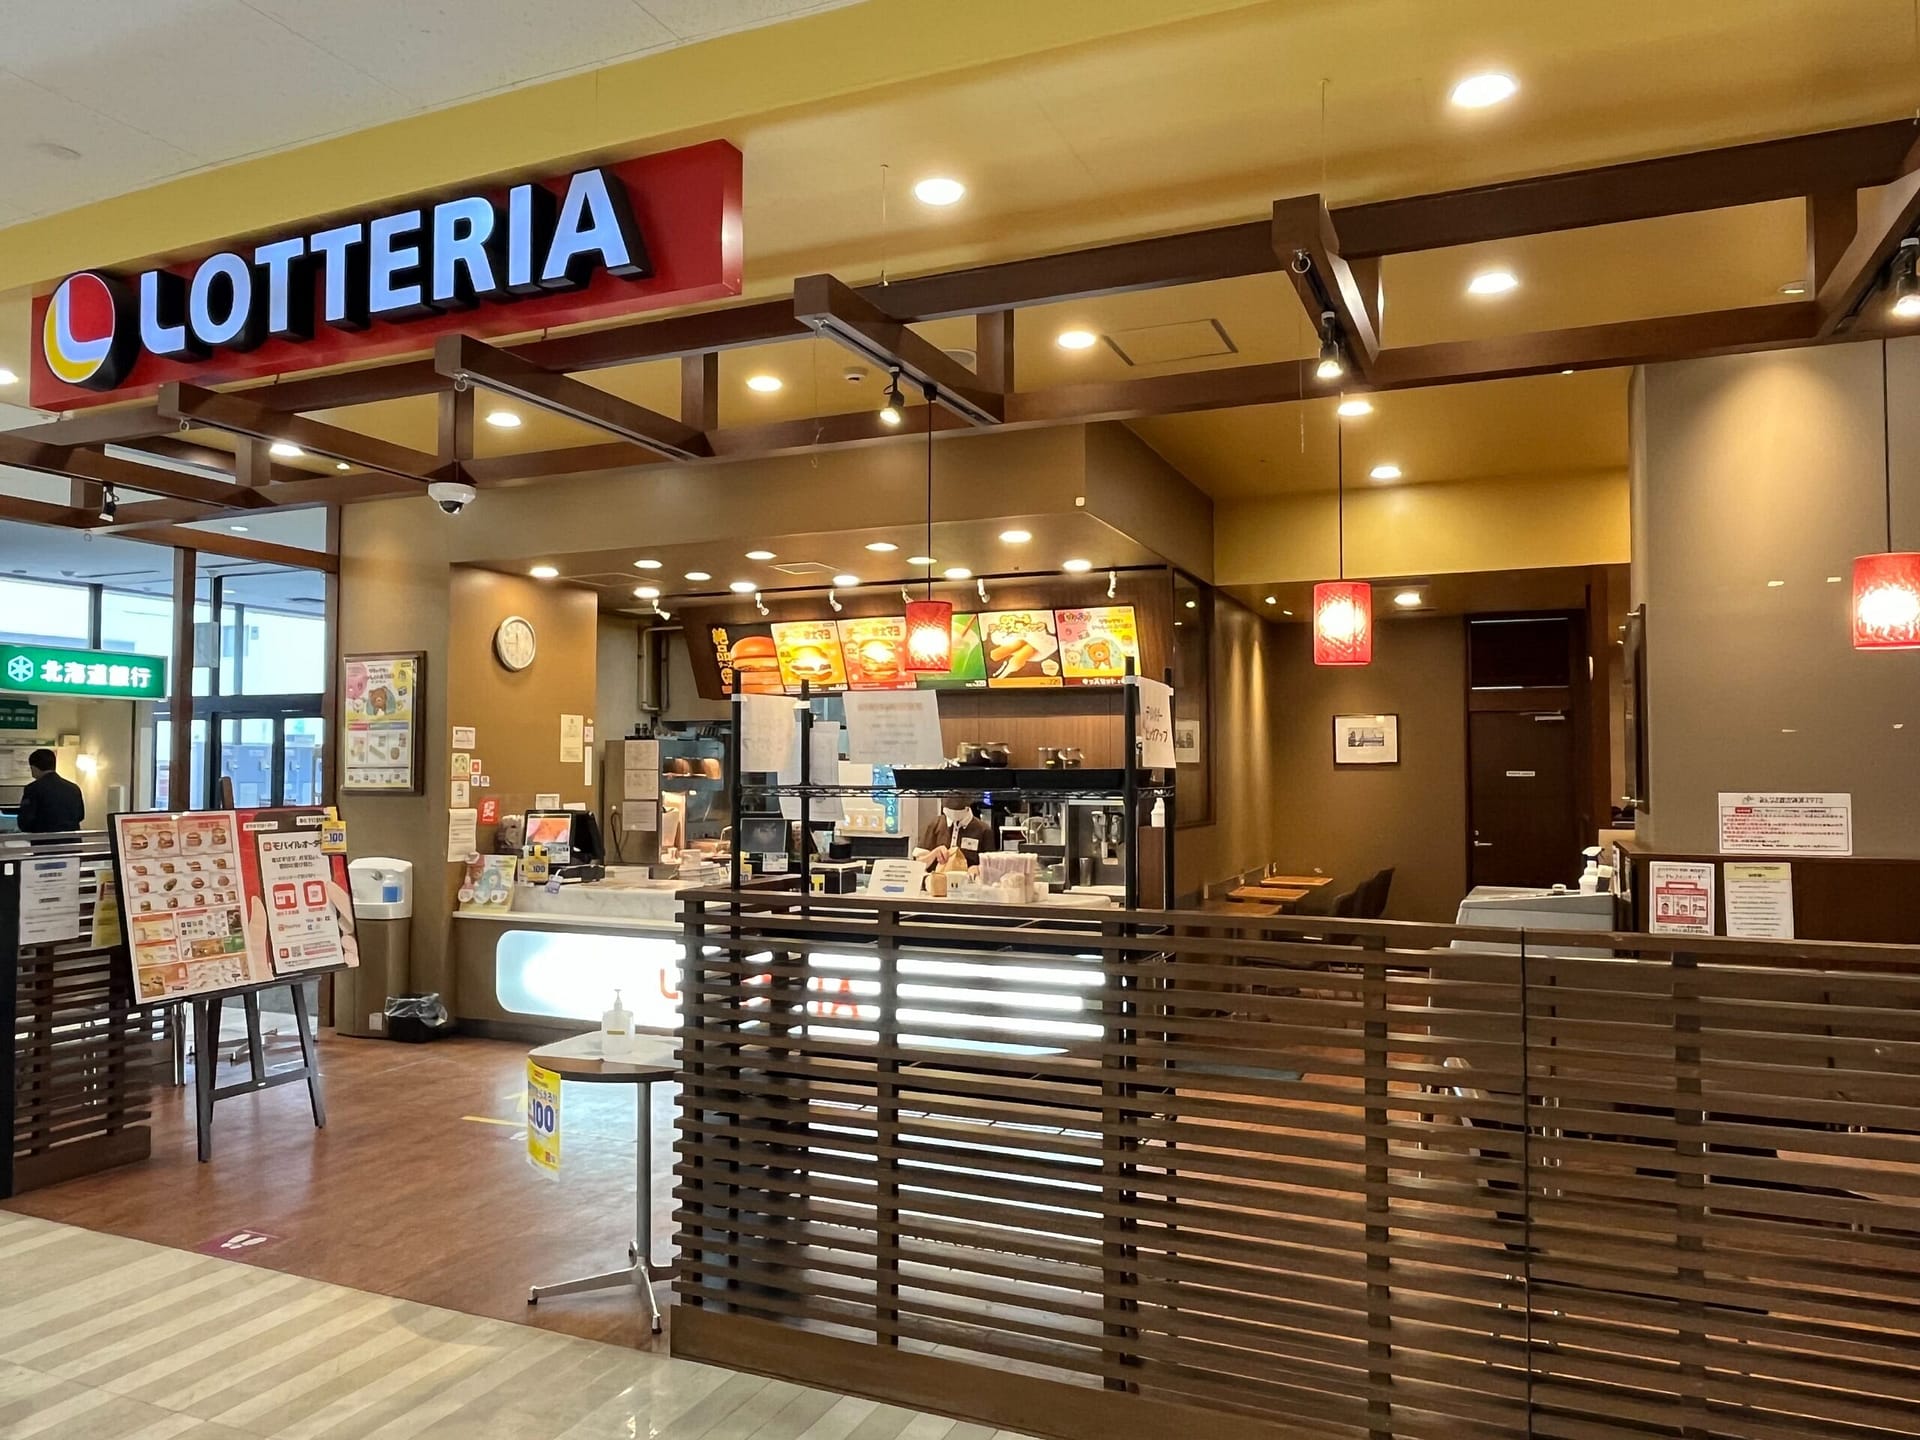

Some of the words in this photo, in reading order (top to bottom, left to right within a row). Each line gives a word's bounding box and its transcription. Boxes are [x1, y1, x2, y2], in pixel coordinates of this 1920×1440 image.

[139, 168, 634, 358] LOTTERIA
[40, 659, 152, 688] 北海道銀行
[271, 840, 322, 851] モバイルオーダ
[532, 1098, 555, 1133] 100
